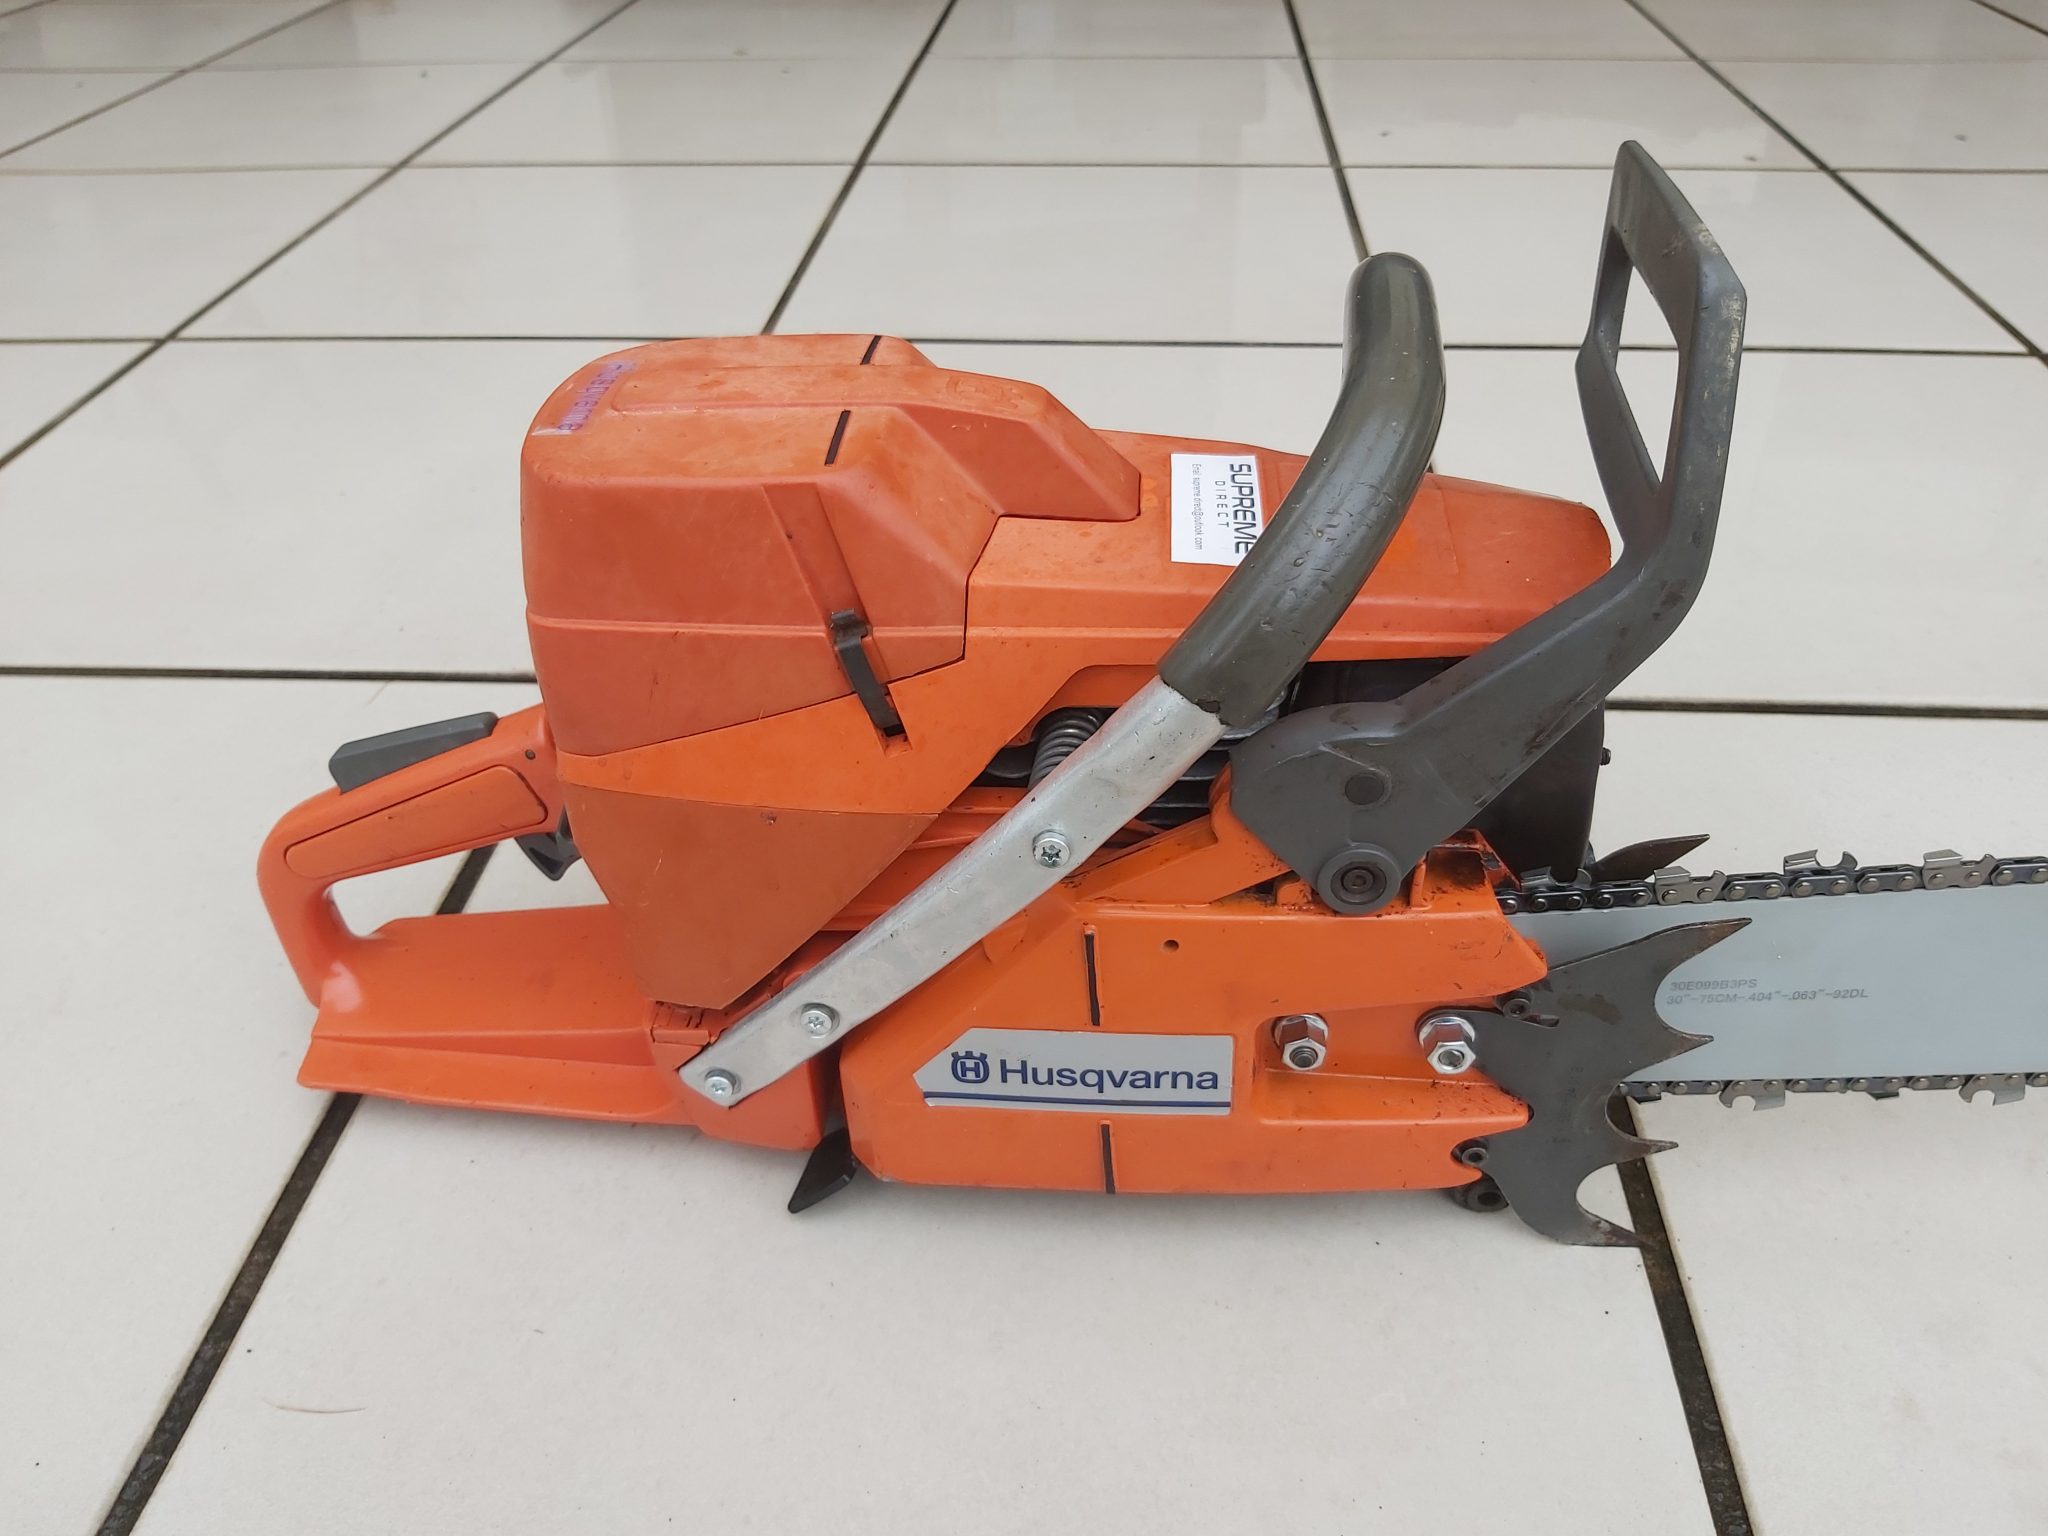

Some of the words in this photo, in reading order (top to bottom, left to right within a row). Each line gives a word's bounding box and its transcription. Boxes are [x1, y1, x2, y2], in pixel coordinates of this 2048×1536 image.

[1215, 480, 1230, 528] DIRECT
[1229, 463, 1258, 555] SUPREME
[999, 1058, 1219, 1094] Husqvarna
